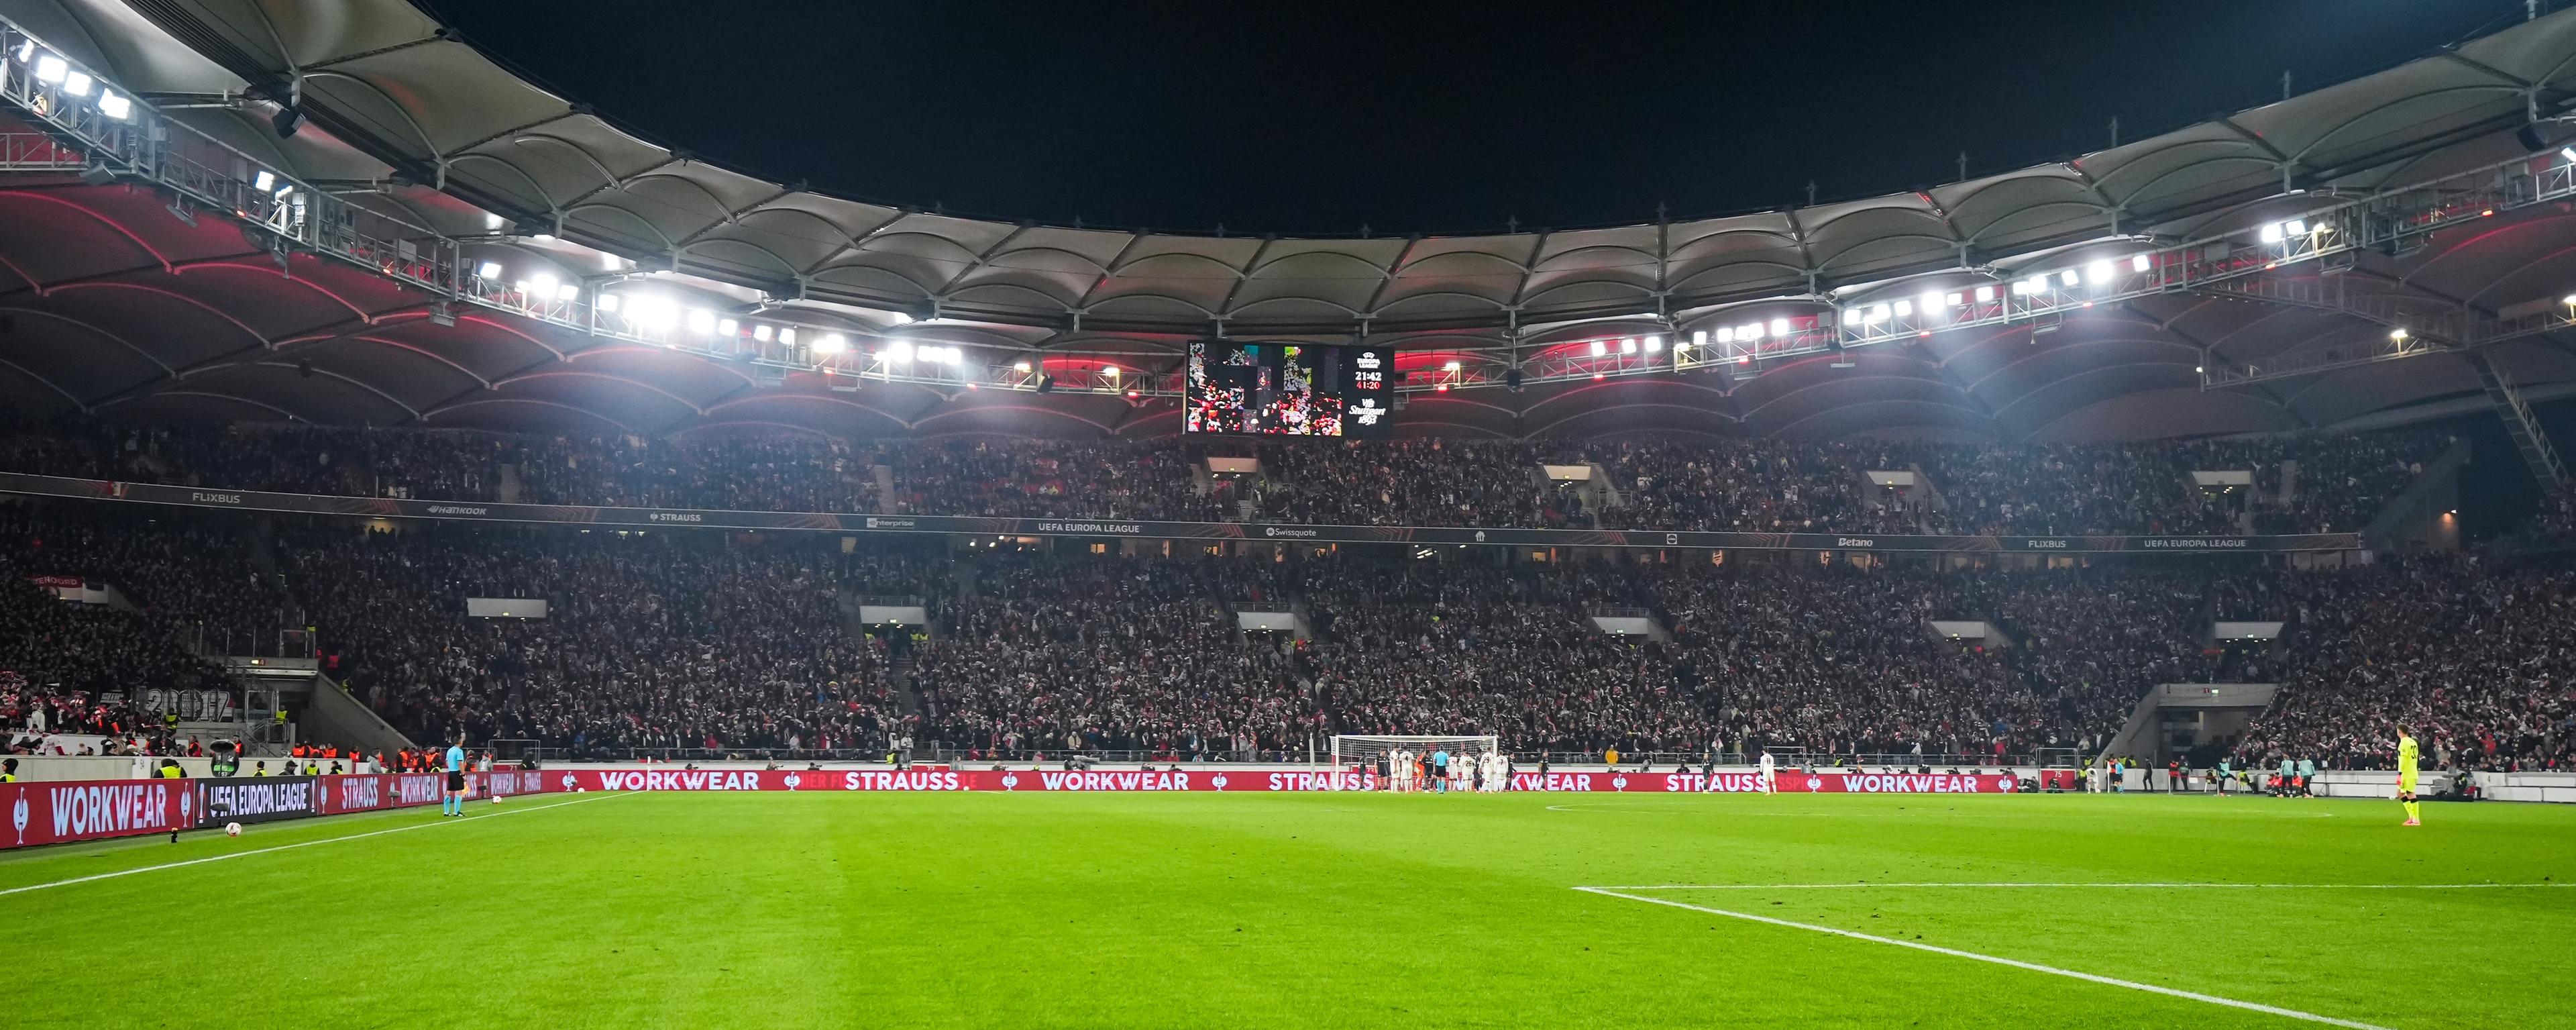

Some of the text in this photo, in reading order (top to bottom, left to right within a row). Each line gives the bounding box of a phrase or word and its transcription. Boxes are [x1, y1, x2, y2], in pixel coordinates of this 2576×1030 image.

[1355, 372, 1382, 381] 21:42
[1356, 381, 1381, 389] 41:20
[1348, 405, 1387, 415] Stuttgart
[1358, 414, 1377, 425] 1893
[660, 513, 701, 522] STRAUSS
[1065, 523, 1102, 532] EUROPA
[1104, 525, 1140, 533] LEAGUE
[1275, 528, 1317, 537] Swissquote
[1838, 537, 1874, 547] Betano
[2145, 539, 2246, 548] UEFA EUROPA LEAGUE
[400, 775, 438, 804] WORKWEAR
[490, 773, 515, 795] WORKWEAR
[525, 772, 541, 792] STRAUSS
[599, 772, 759, 790] WORKWEAR
[845, 772, 958, 790] STRAUSS
[1041, 772, 1189, 790] WORKWEAR
[1269, 773, 1375, 791] STRAUSS
[1666, 774, 1767, 792] STRAUSS
[1842, 775, 1978, 792] WORKWEAR
[210, 783, 308, 817] UEFA EUROPA LEAGUE
[342, 776, 378, 810] STRAUSS
[51, 784, 166, 837] WORKWEAR
